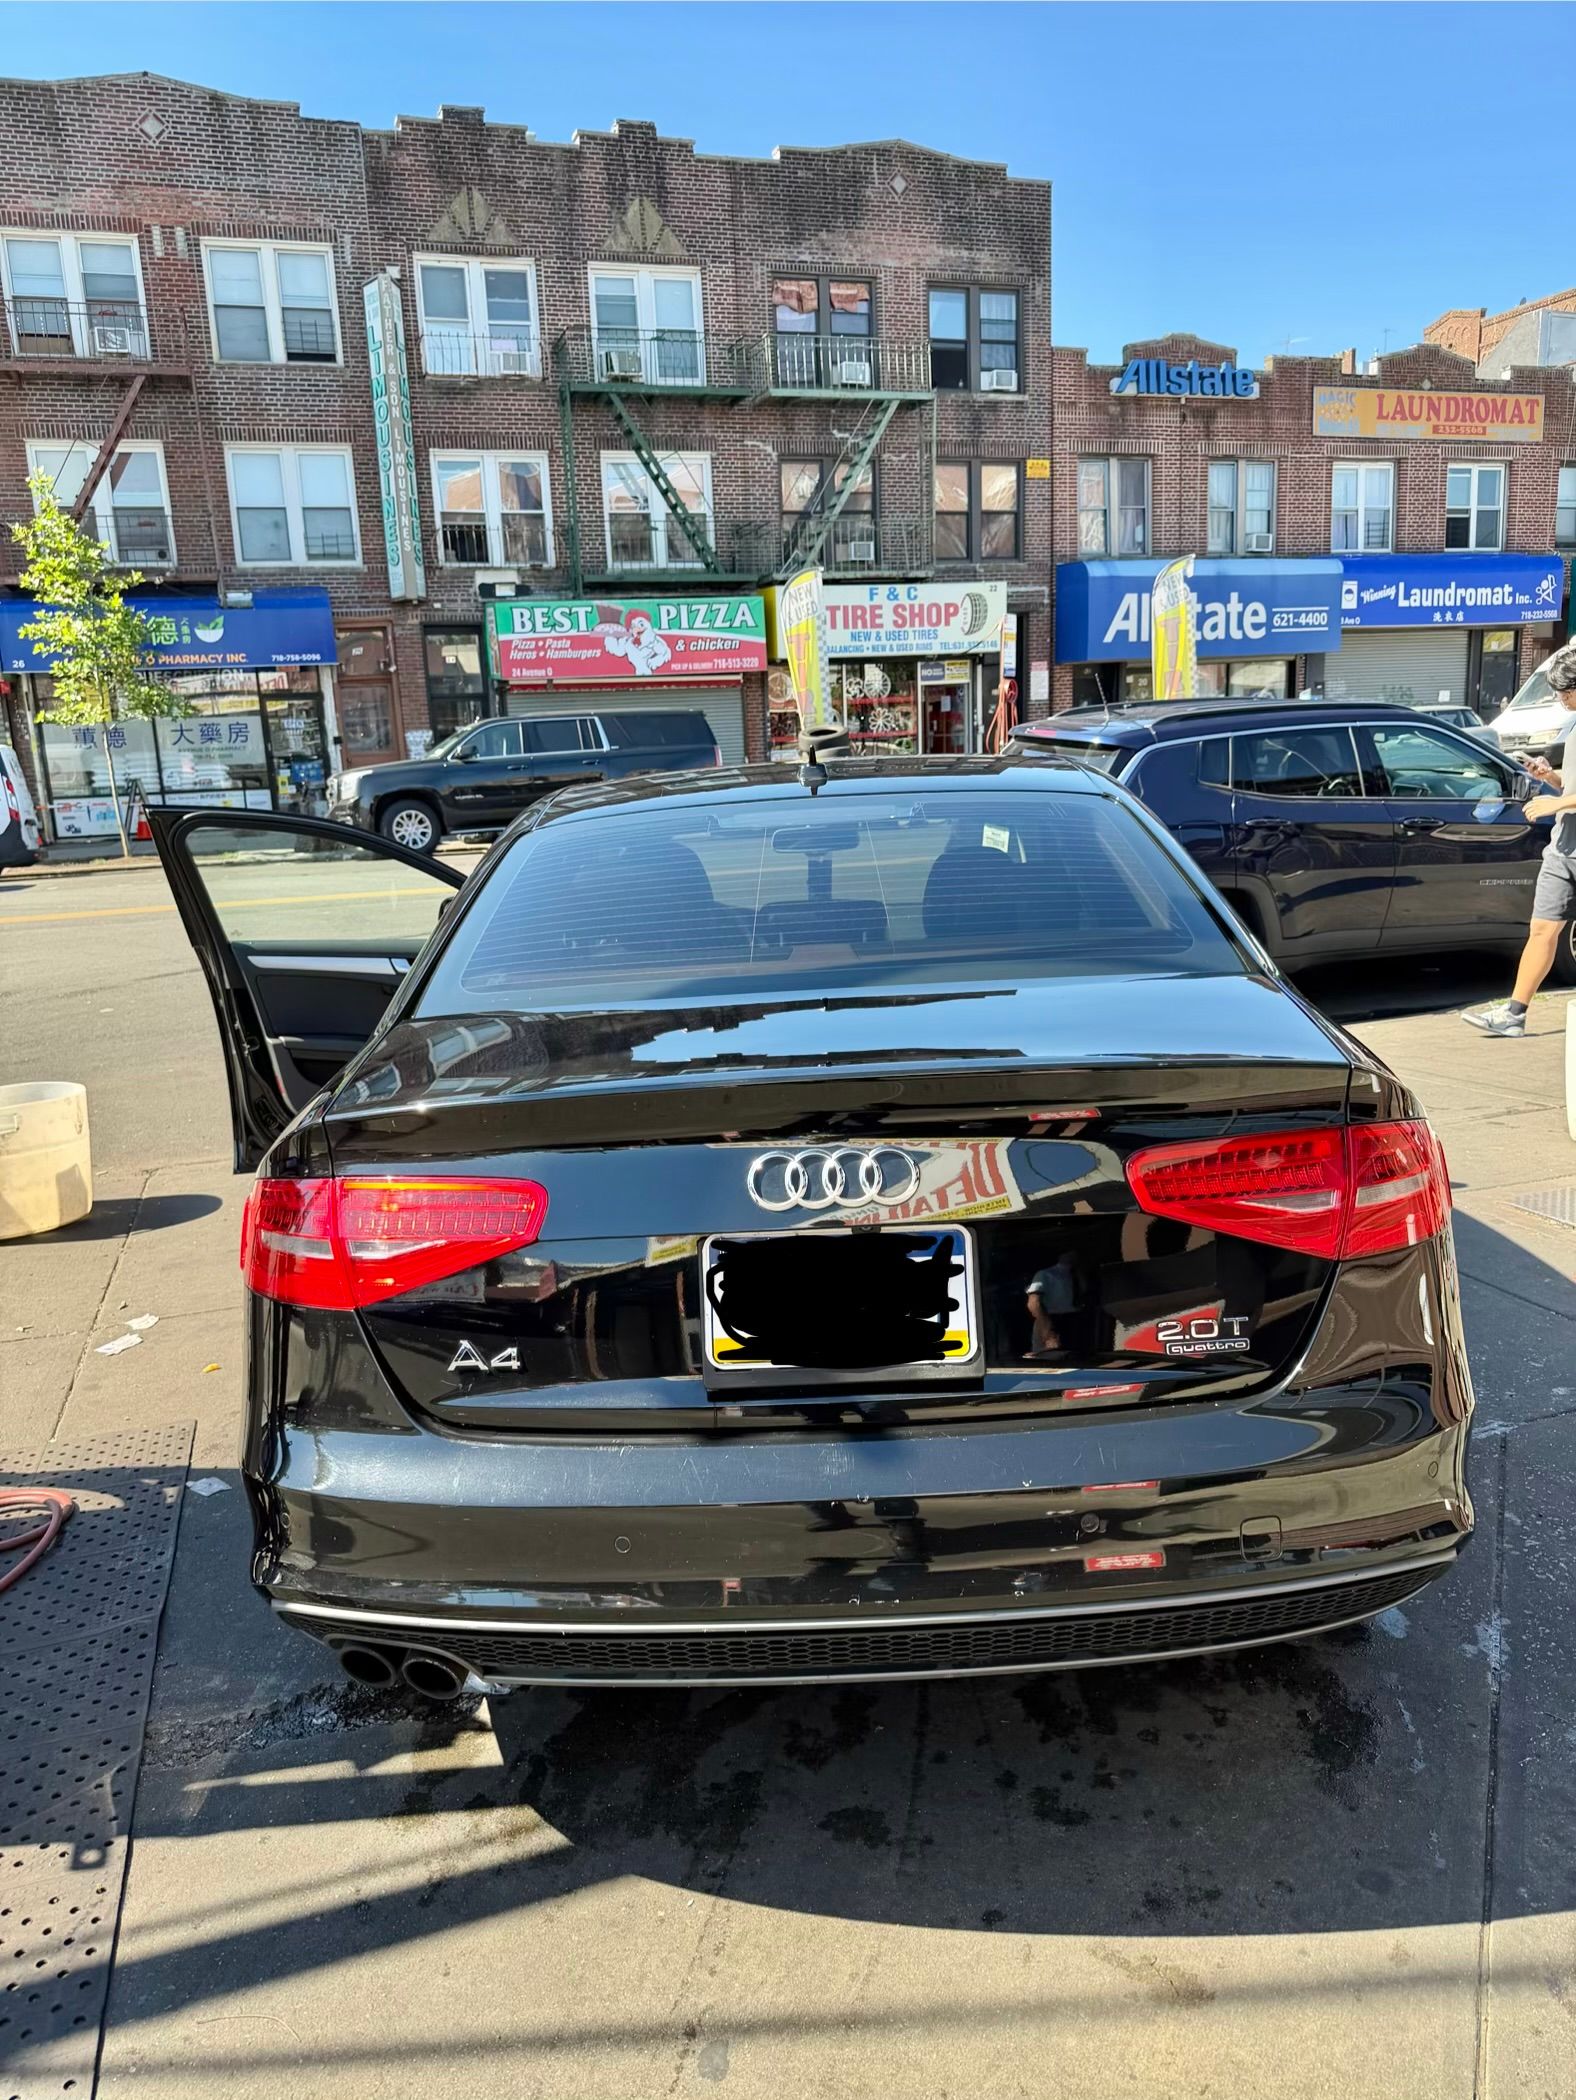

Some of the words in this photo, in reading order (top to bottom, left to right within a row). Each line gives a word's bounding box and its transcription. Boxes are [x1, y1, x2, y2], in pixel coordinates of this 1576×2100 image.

[381, 278, 394, 355] FATHER
[388, 363, 396, 375] &
[1115, 359, 1255, 397] Allstate
[389, 382, 400, 418] SON
[1376, 393, 1540, 424] LAUNDROMAT
[368, 326, 400, 567] LIMOUSINES
[394, 428, 411, 551] LIMOUSINES
[788, 582, 812, 606] NEW
[869, 587, 879, 601] F
[887, 586, 899, 600] &
[907, 586, 918, 600] C
[1360, 584, 1396, 604] Winning
[1398, 581, 1513, 607] Laundromat
[1515, 592, 1533, 604] Inc.
[511, 605, 593, 634] BEST
[657, 602, 758, 630] PIZZA
[825, 603, 884, 630] TIRE
[892, 602, 960, 630] SHOP
[1103, 592, 1267, 643] Altate
[1272, 612, 1328, 627] 621-4400
[511, 639, 535, 650] Pizza
[545, 638, 571, 649] Pasta
[676, 639, 685, 652] &
[689, 637, 740, 651] chicken
[850, 631, 871, 642] NEW
[875, 630, 882, 641] &
[885, 630, 909, 641] USED
[916, 629, 939, 641] TIRES
[158, 653, 223, 665] PHARMACY
[226, 653, 248, 663] INC.
[509, 649, 537, 660] Heros
[546, 648, 601, 660] Hamburgers
[871, 644, 888, 653] NEW
[889, 644, 895, 652] &
[896, 643, 914, 652] USED
[12, 660, 25, 668] 26
[512, 668, 521, 677] 24
[171, 721, 250, 747] 大藥房
[447, 1340, 521, 1372] A4
[1170, 1340, 1247, 1355] quattro
